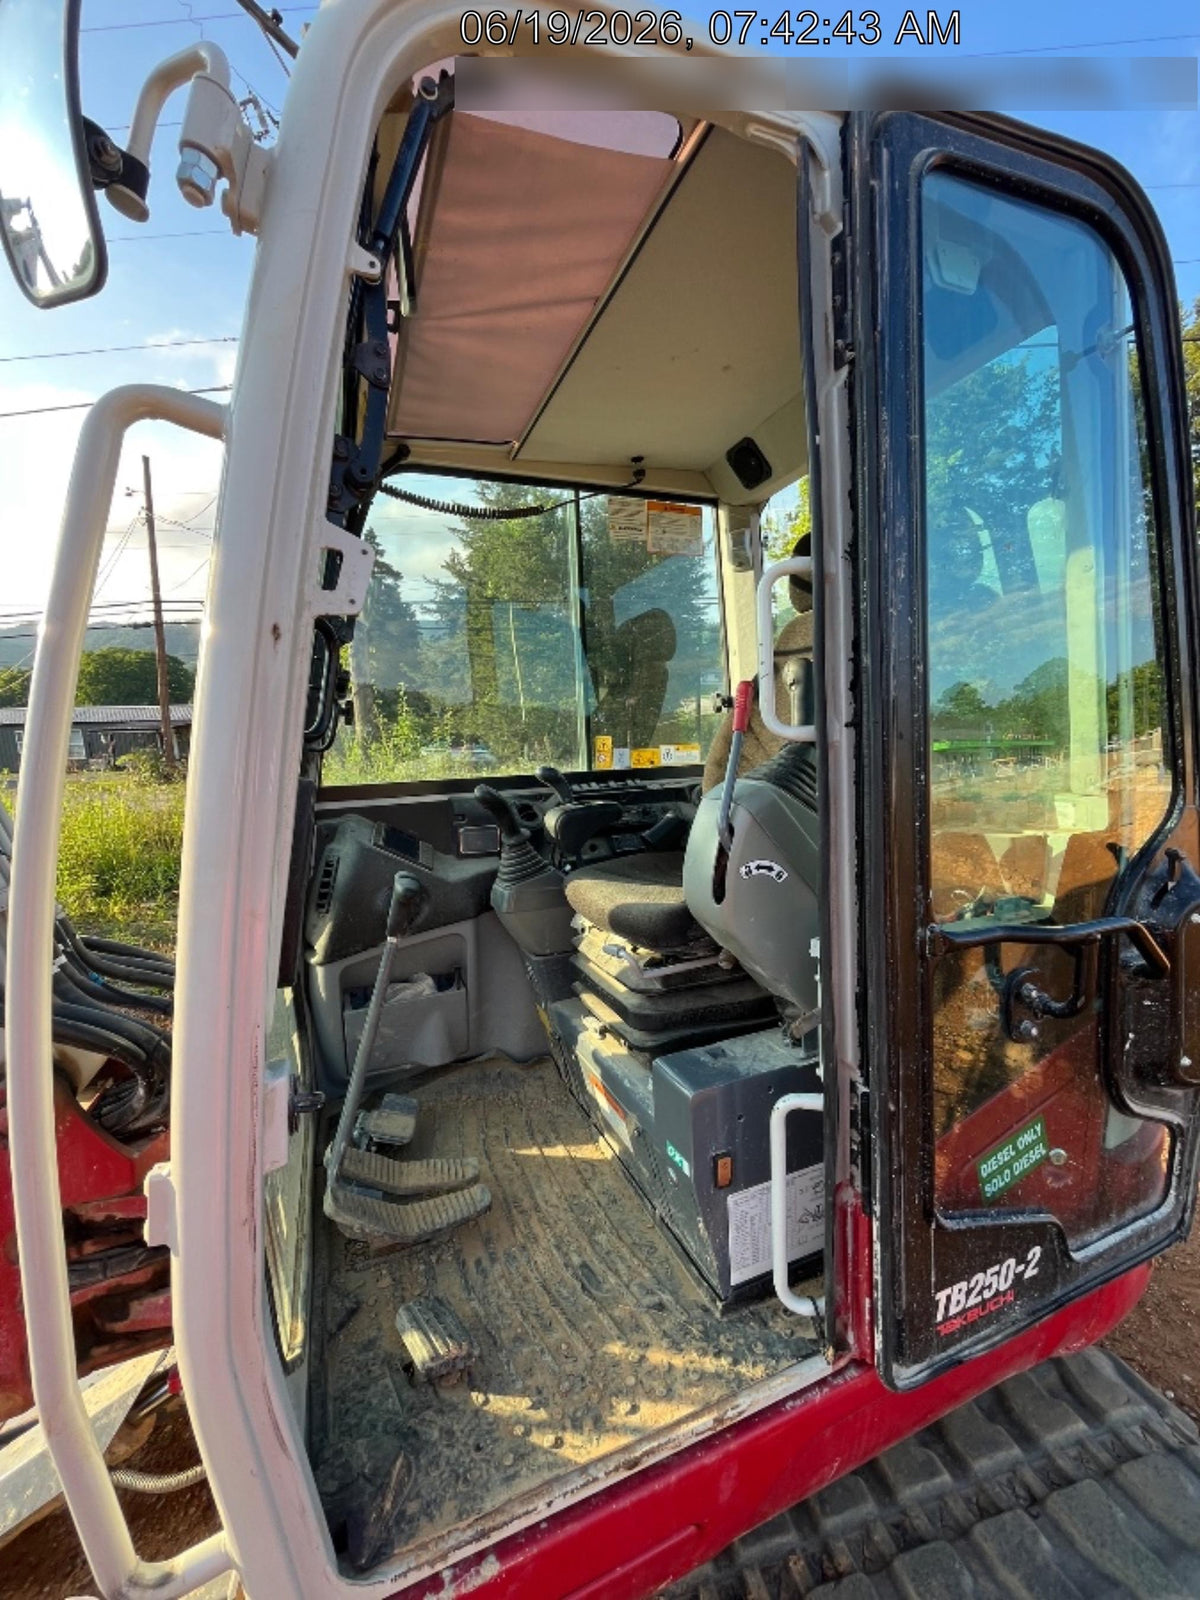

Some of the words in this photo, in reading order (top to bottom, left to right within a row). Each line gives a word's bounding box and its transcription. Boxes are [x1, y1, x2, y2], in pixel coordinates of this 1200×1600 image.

[981, 1144, 1016, 1178] DIESEL
[1017, 1122, 1041, 1150] ONLY
[985, 1169, 1011, 1197] SOLO
[1013, 1142, 1046, 1176] DIESEL
[935, 1245, 1042, 1324] TB250-2
